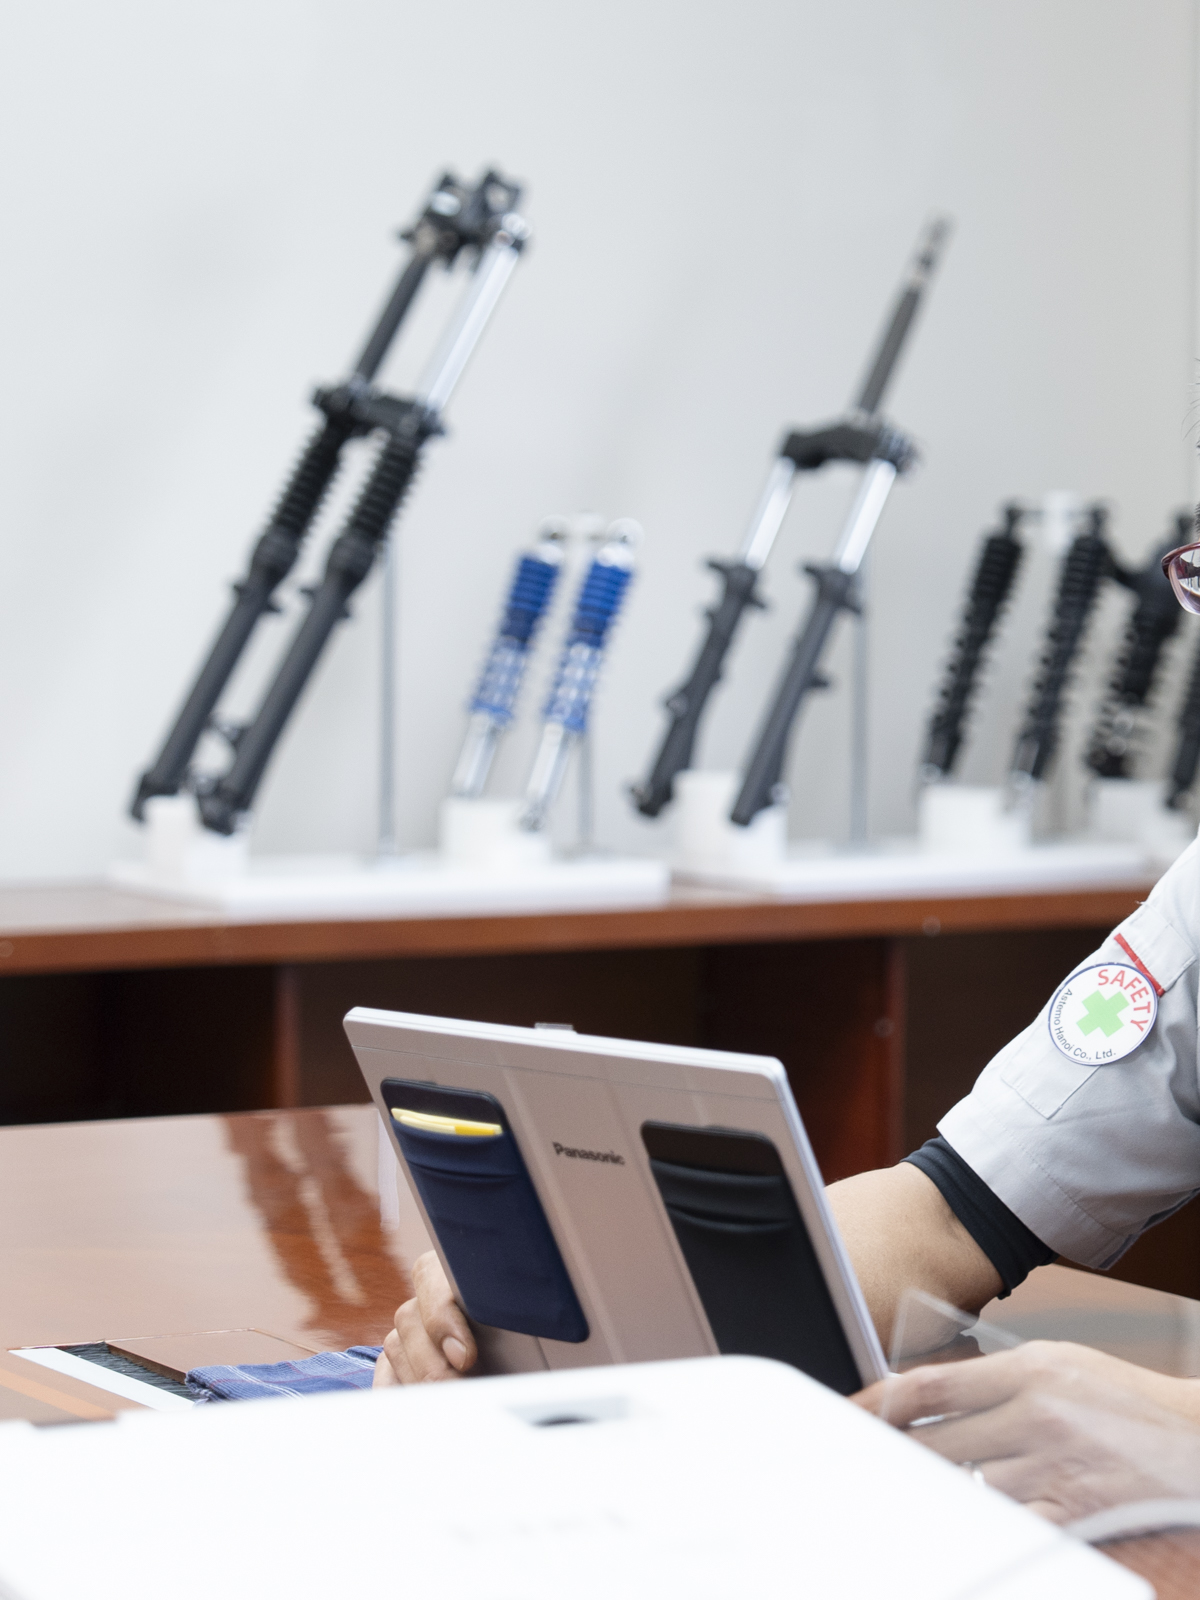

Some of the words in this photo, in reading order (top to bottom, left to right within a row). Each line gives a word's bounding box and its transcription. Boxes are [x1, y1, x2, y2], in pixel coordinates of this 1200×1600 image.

[1053, 988, 1073, 1026] Astemo
[1097, 968, 1151, 1032] SAFETY
[1054, 1026, 1075, 1052] Hanoi
[1073, 1047, 1092, 1061] Co.,
[1095, 1049, 1117, 1060] Ltd.
[552, 1141, 625, 1166] Panasonic
